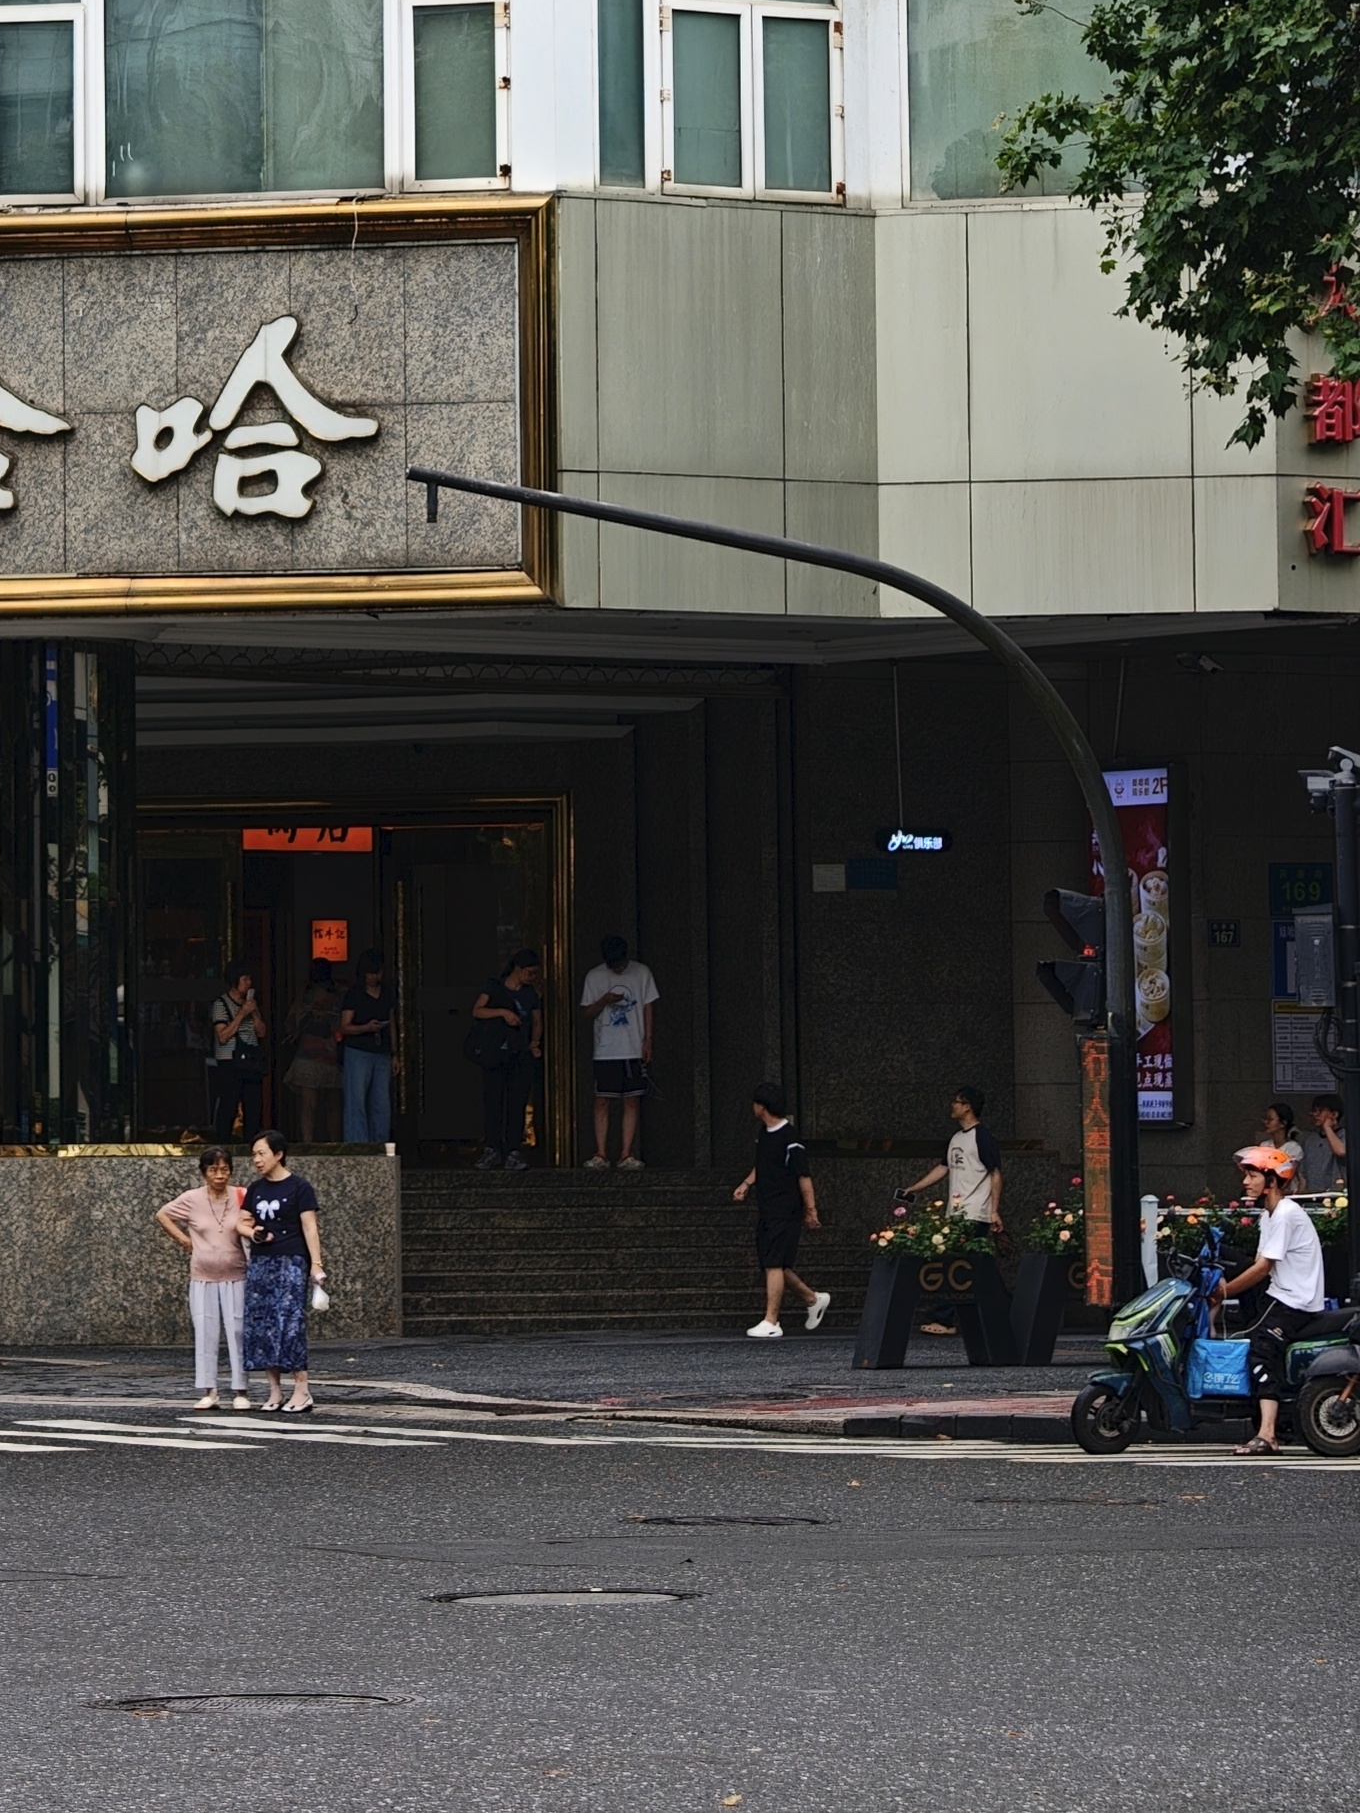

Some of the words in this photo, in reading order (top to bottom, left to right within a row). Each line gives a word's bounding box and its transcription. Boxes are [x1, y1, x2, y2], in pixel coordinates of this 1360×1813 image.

[1281, 880, 1322, 903] 169
[1214, 930, 1235, 944] 167
[918, 1259, 973, 1292] GC
